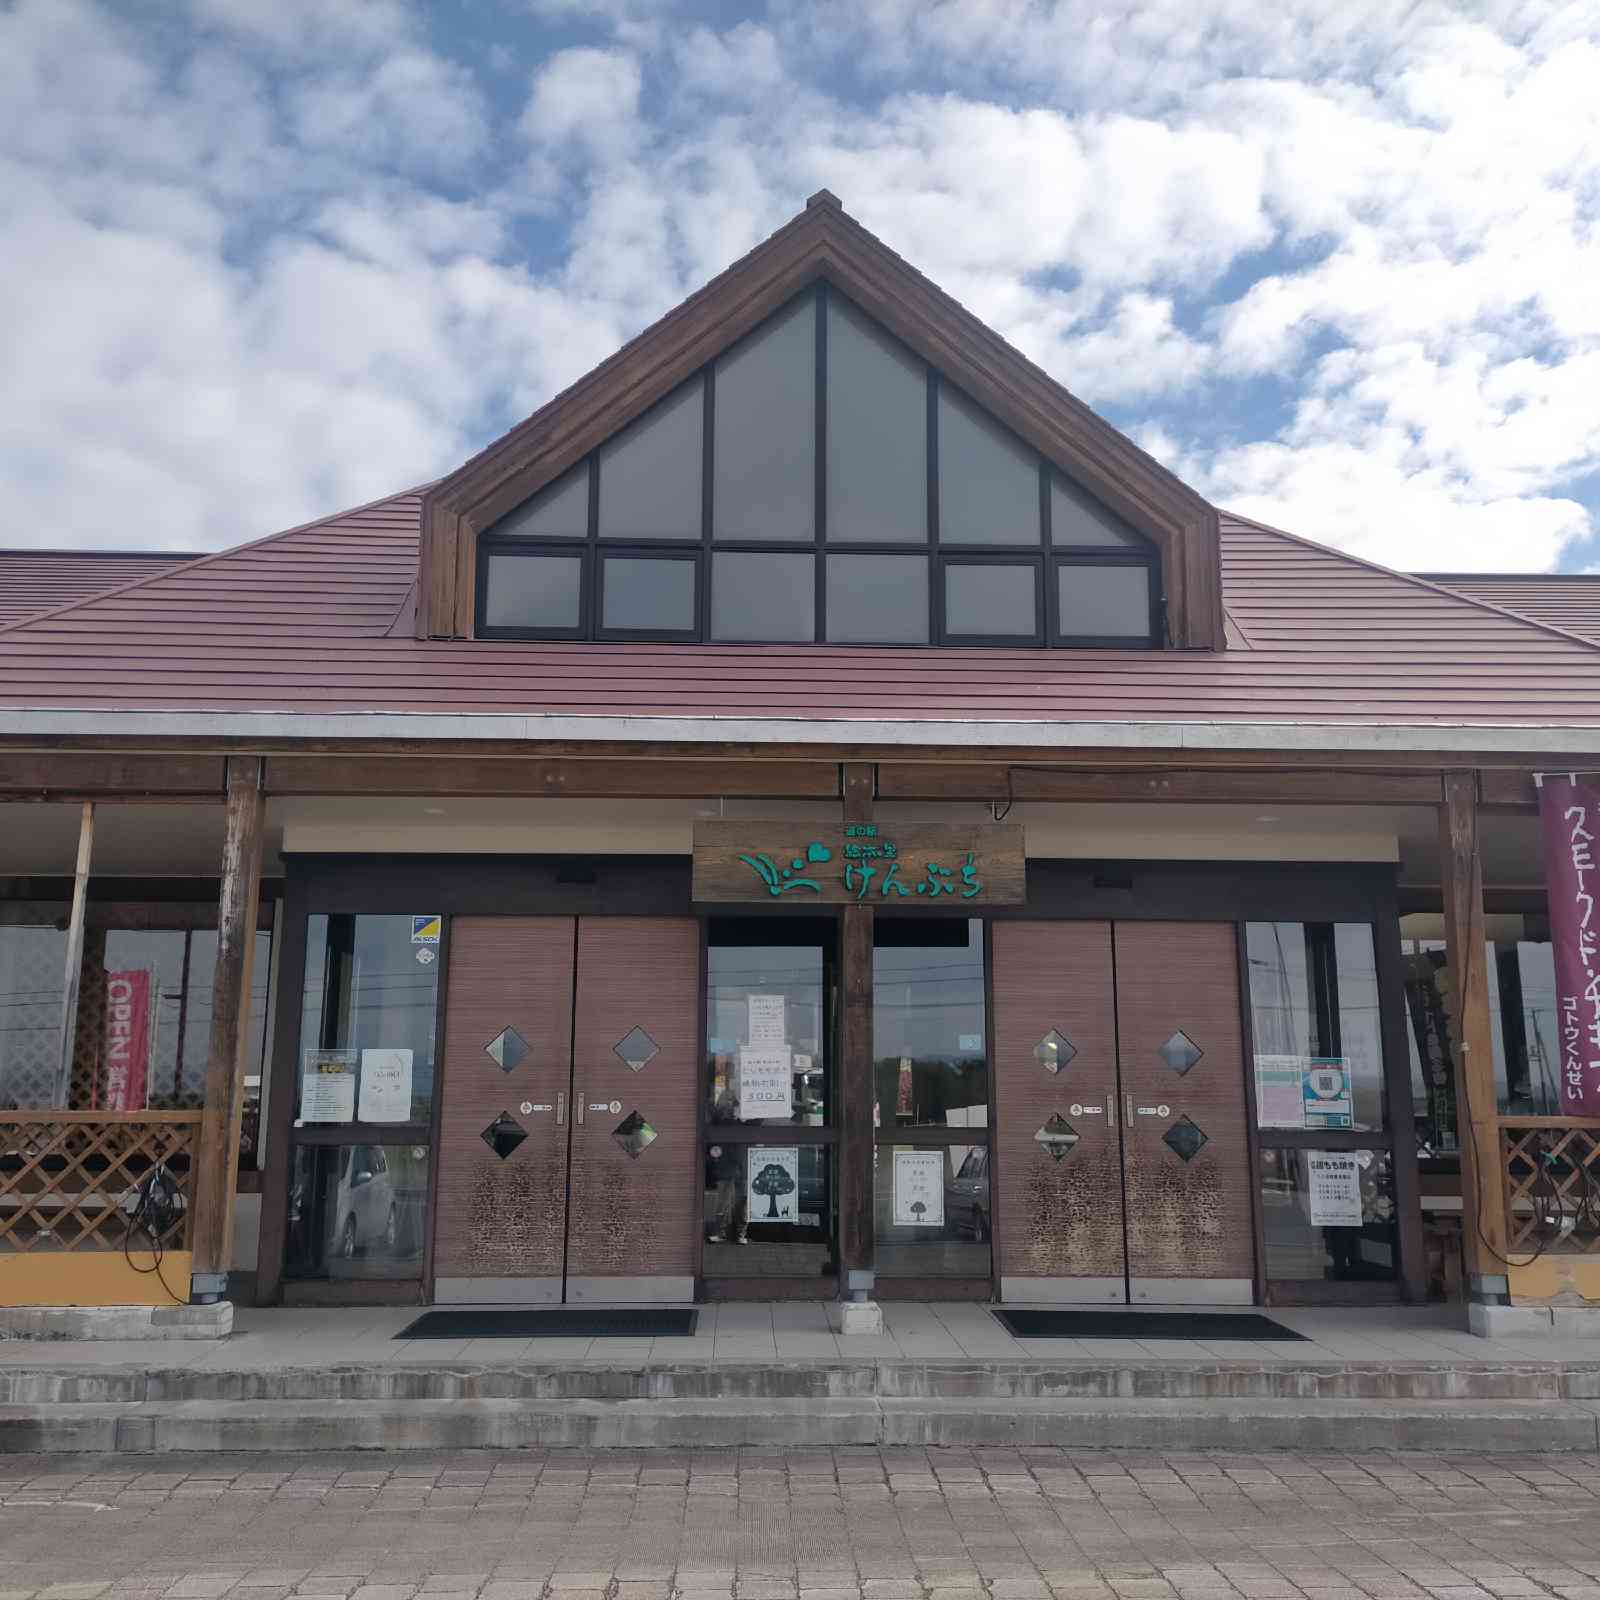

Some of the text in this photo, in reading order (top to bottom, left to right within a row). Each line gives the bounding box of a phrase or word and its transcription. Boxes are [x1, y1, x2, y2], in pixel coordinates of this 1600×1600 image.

[842, 852, 983, 899] けんぶち
[107, 979, 132, 1060] OPEN
[1563, 995, 1585, 1101] ゴトウくんせい
